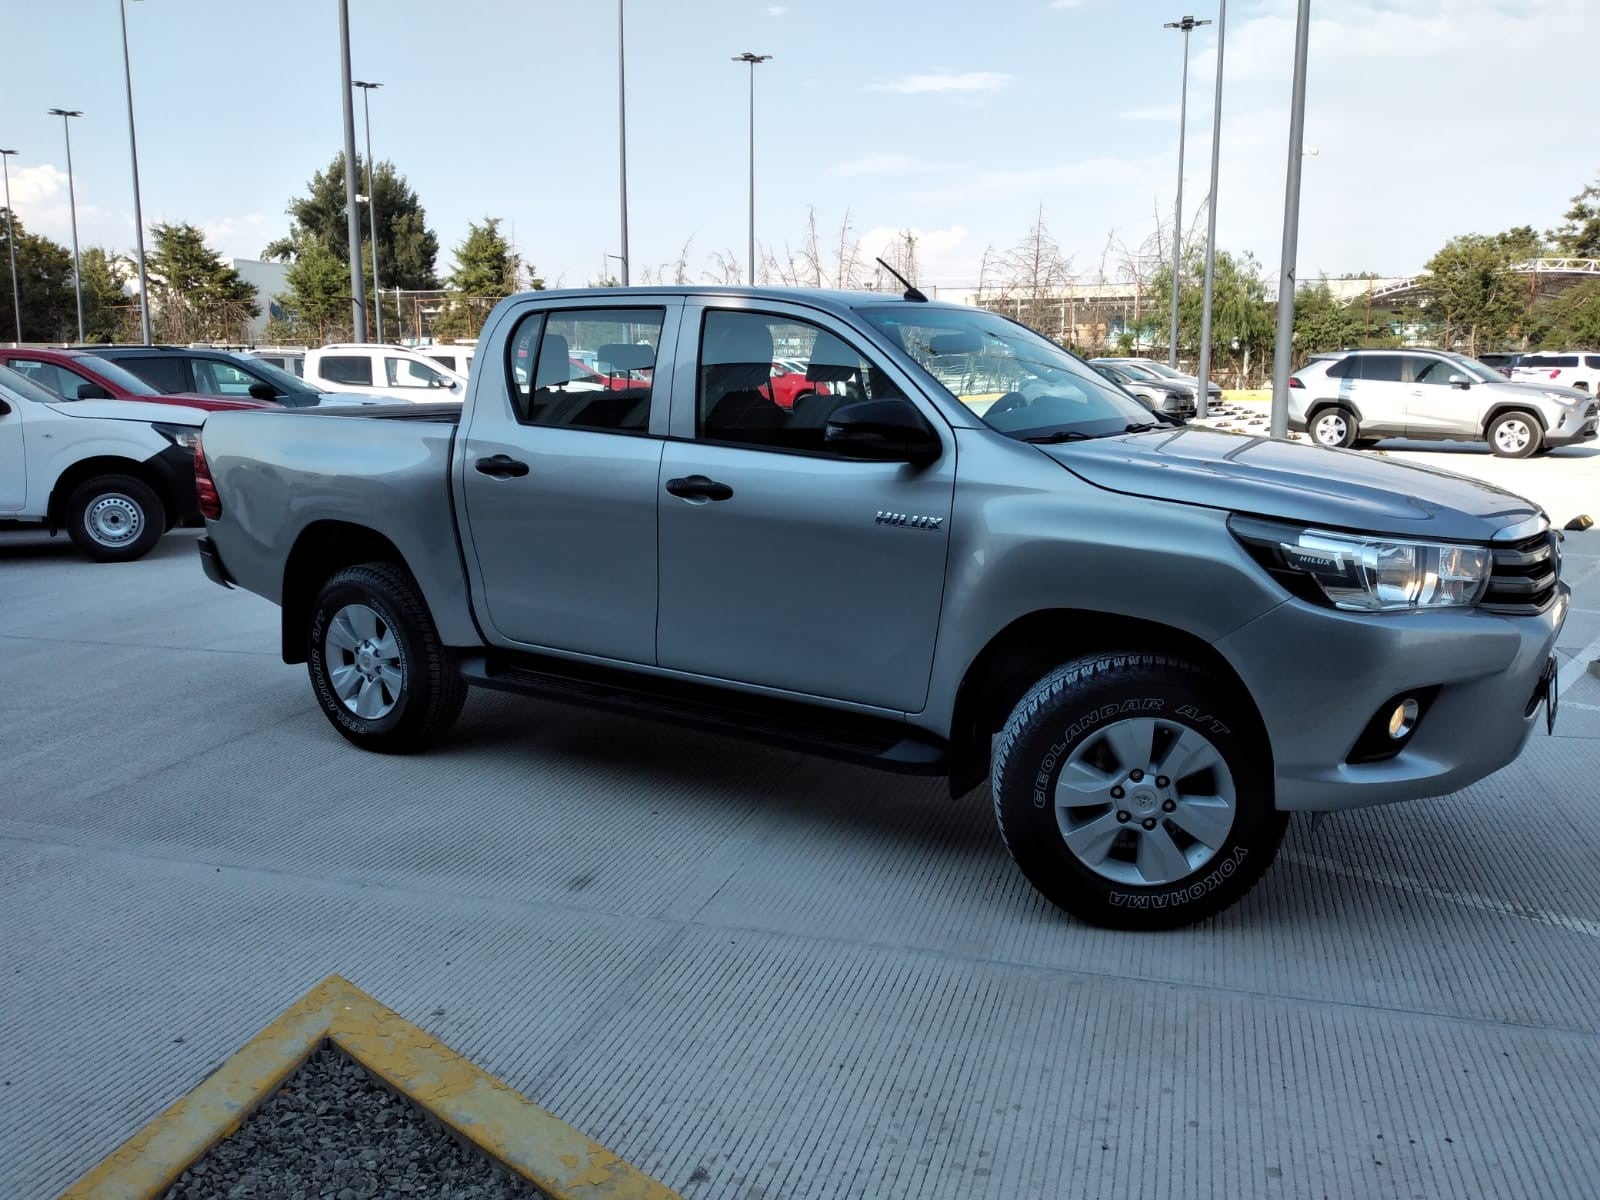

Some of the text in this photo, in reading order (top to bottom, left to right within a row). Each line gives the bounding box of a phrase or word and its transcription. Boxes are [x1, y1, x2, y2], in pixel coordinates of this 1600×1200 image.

[875, 510, 944, 530] HILUX
[1299, 555, 1331, 566] HILUX
[1034, 698, 1232, 809] GEOLANDAR A/T
[1108, 845, 1249, 910] YOKOHAMA
